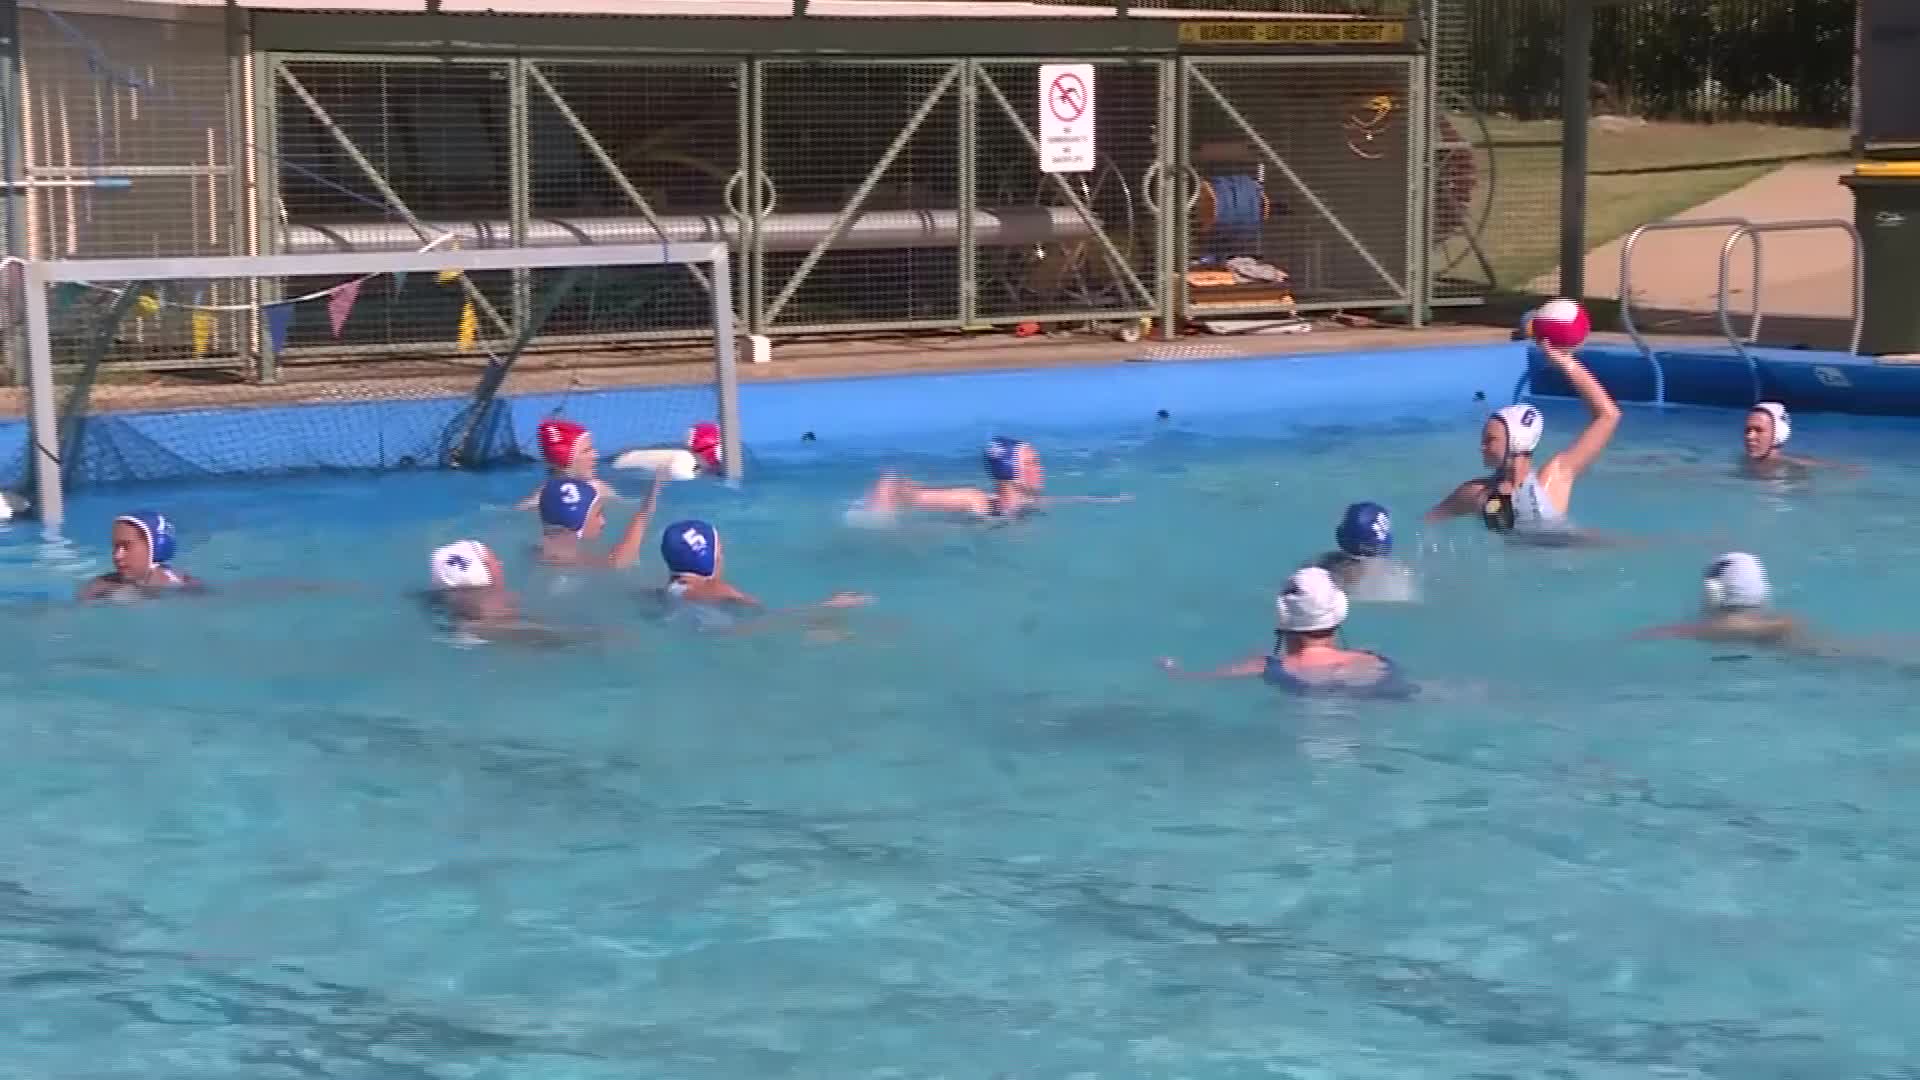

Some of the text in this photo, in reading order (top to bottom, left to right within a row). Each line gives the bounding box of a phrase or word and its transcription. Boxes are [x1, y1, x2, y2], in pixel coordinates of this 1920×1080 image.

[1199, 25, 1257, 40] WARNING
[1265, 25, 1291, 40] LOW
[1294, 25, 1340, 40] CEILING
[1341, 25, 1385, 40] HEIGHT
[1521, 409, 1536, 427] 6
[560, 483, 581, 504] 3
[682, 527, 707, 551] 5
